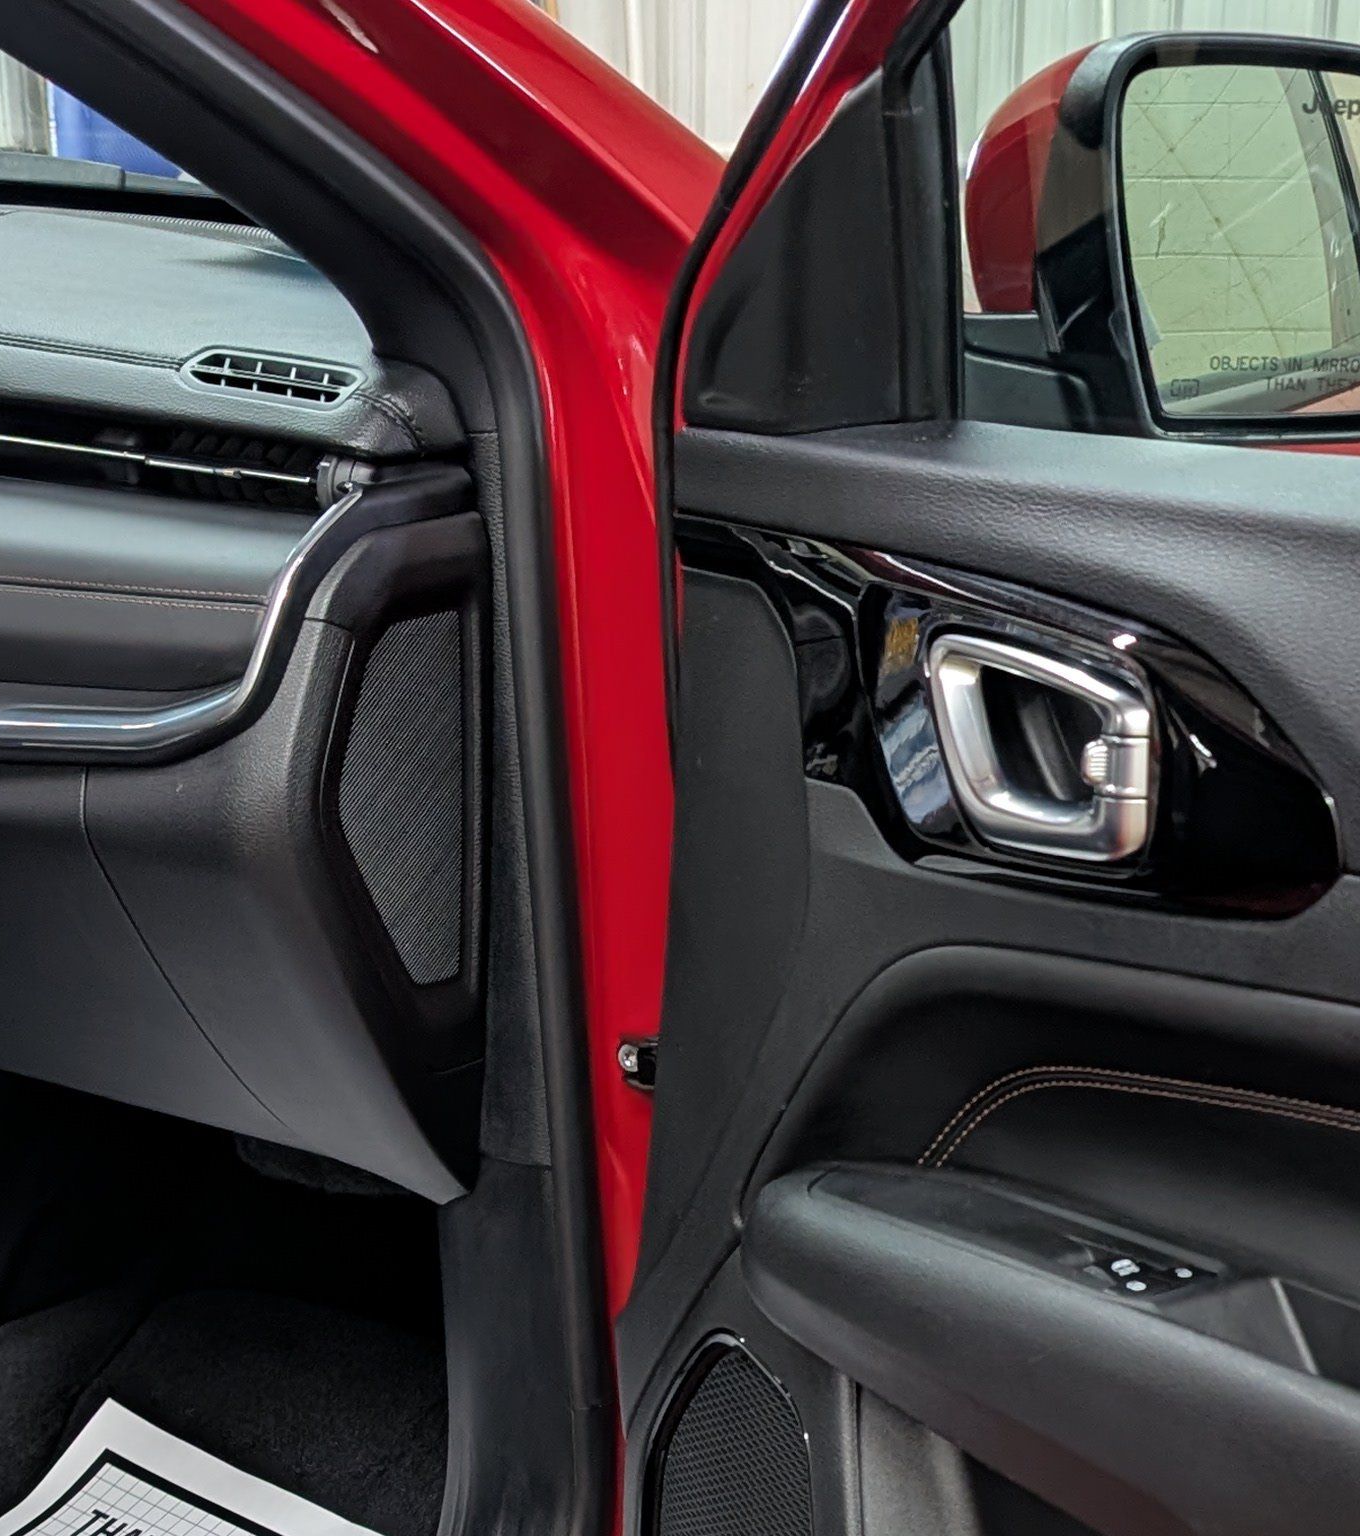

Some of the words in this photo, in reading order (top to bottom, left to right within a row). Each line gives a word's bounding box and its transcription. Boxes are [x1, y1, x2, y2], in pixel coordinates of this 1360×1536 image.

[1209, 355, 1279, 372] OBJECTS
[1287, 357, 1303, 371] IN
[1265, 377, 1308, 392] THAN
